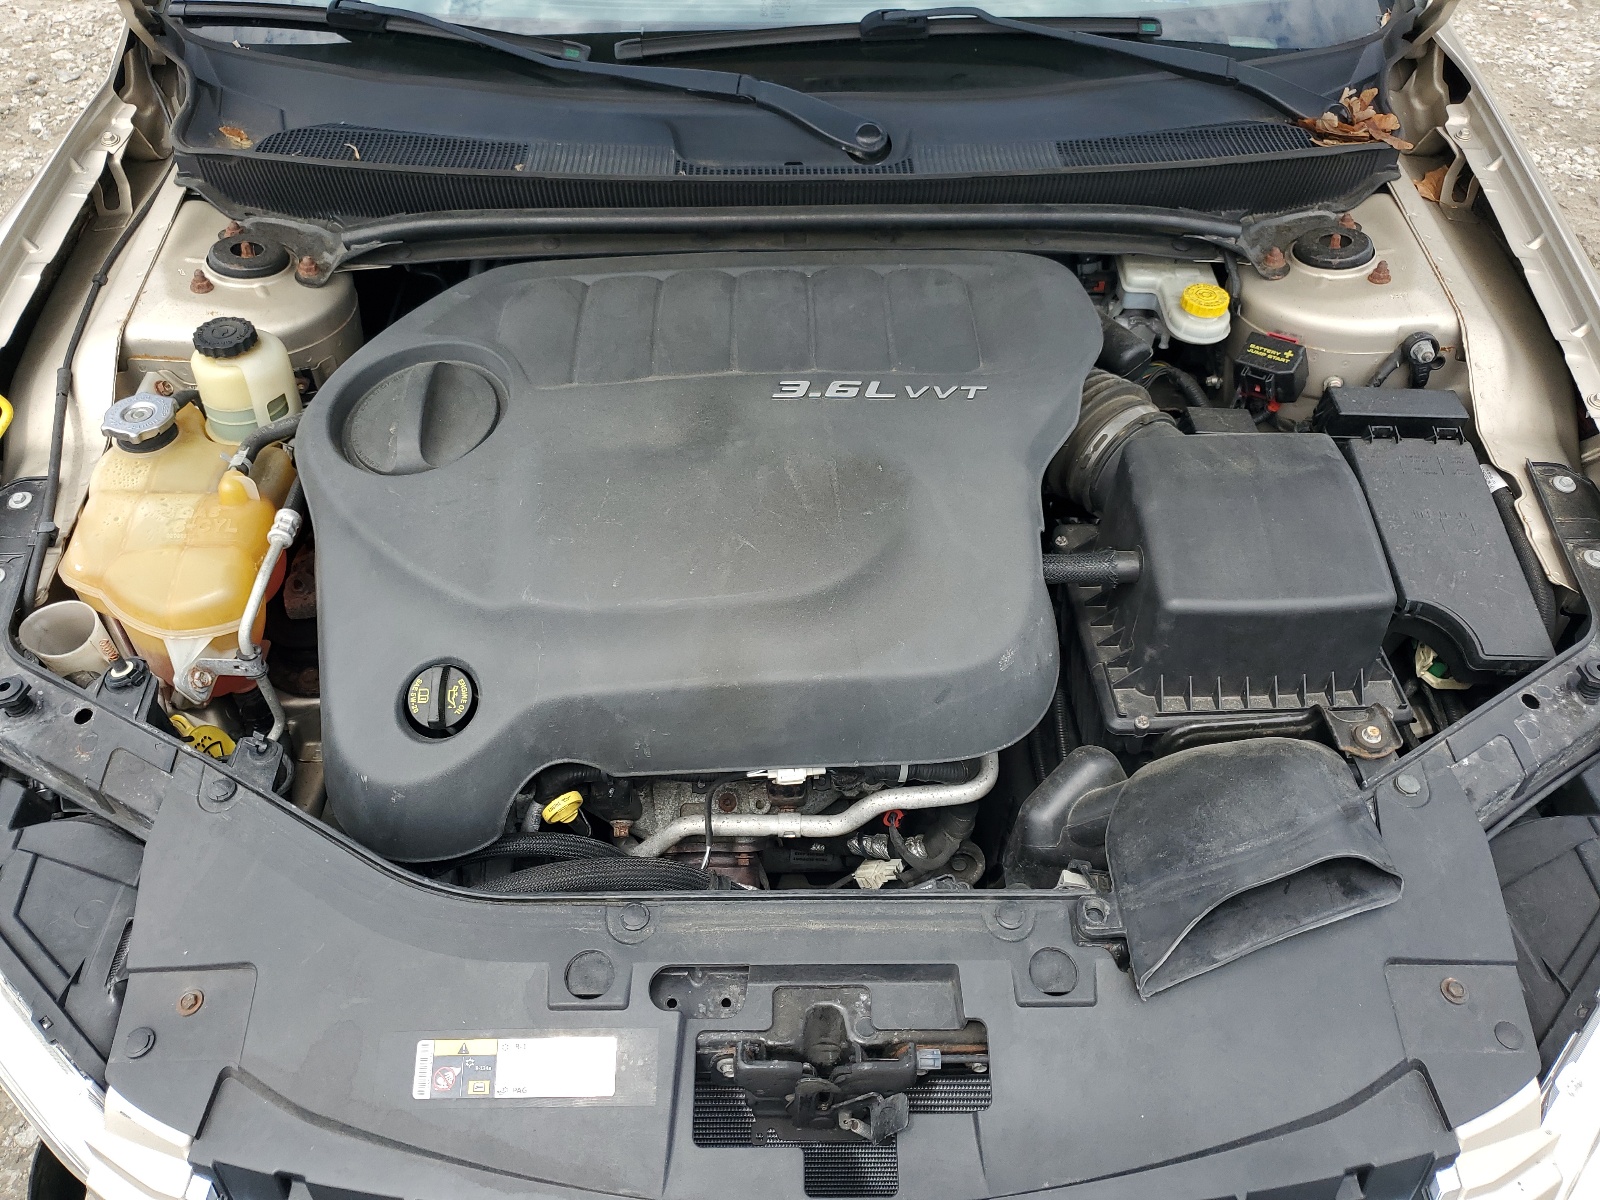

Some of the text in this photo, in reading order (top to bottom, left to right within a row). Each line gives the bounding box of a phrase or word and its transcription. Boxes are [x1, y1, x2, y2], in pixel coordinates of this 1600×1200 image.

[1247, 349, 1291, 363] JUMP START
[1250, 343, 1281, 356] BATTERY
[772, 380, 988, 399] 3.6L VVT
[410, 678, 423, 714] SAE 5W-20
[454, 678, 468, 715] ENGINE OIL
